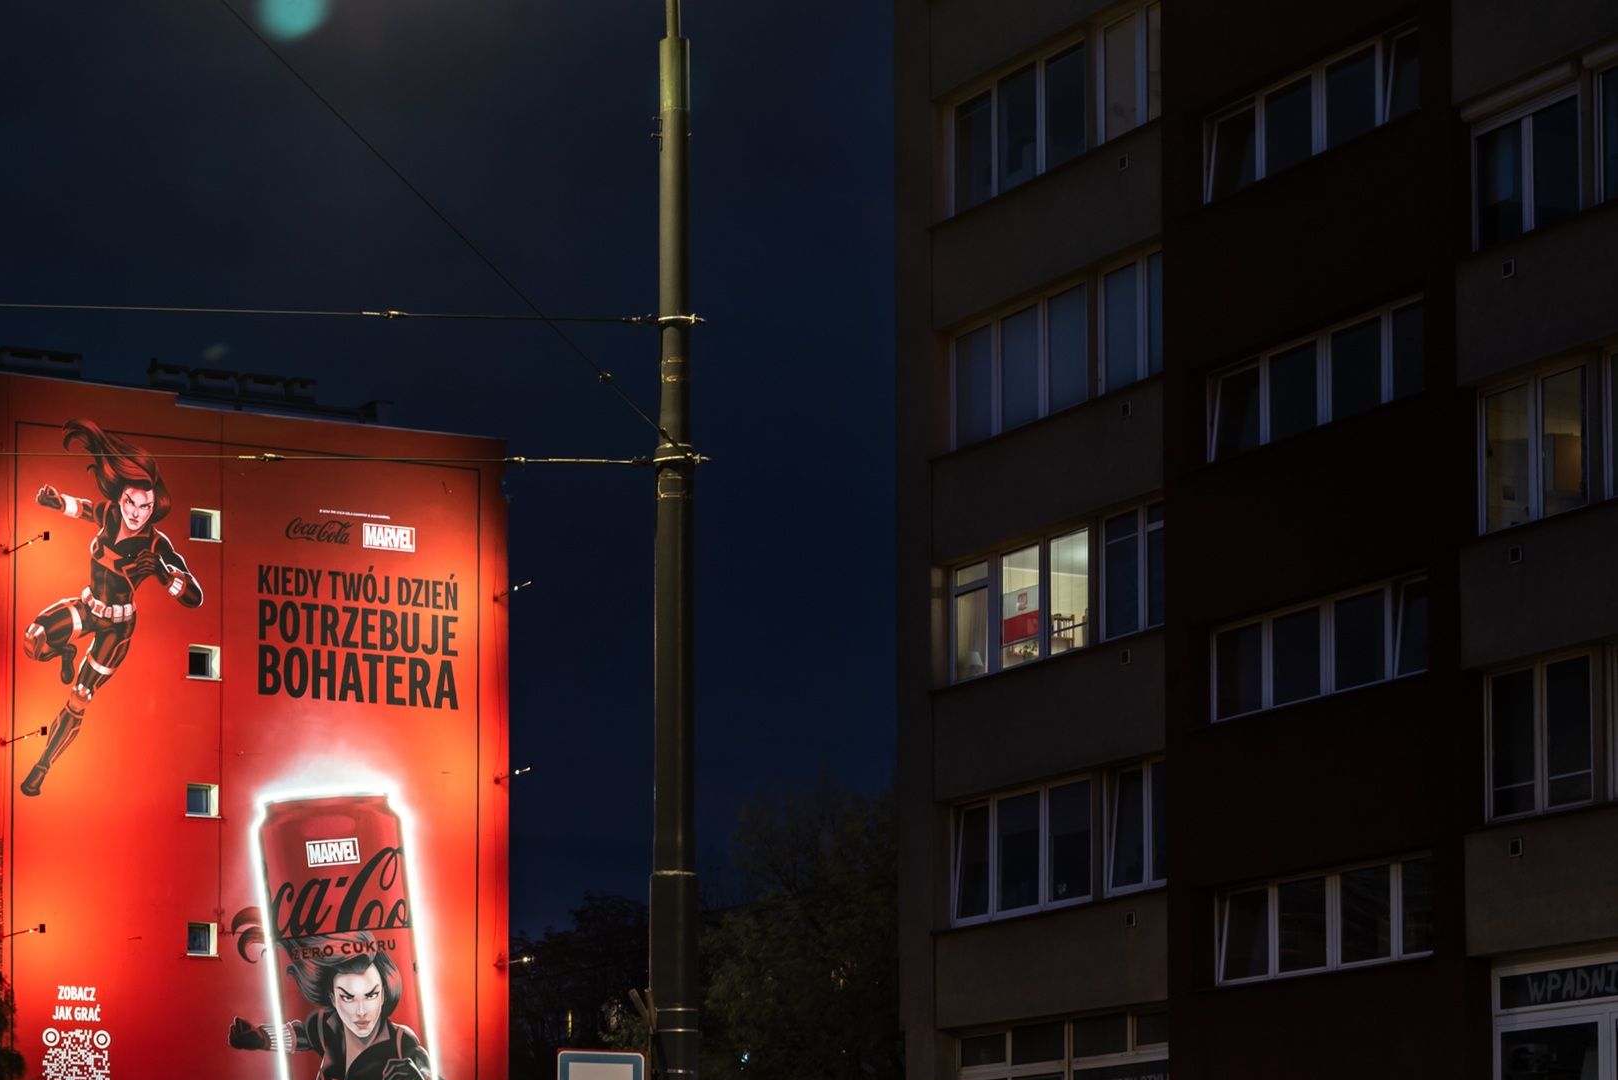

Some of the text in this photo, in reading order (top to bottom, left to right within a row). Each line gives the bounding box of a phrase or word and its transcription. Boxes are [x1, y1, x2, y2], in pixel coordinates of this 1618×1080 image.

[364, 524, 413, 550] MARVEL
[258, 564, 458, 611] KIEDY TWÓJ DZIEŃ
[258, 598, 459, 657] POTRZEBUJE
[257, 643, 459, 711] BOHATERA
[308, 840, 358, 865] MARVEL
[293, 938, 396, 960] ZERO CUKRU
[57, 985, 96, 1001] ZOBACZ
[1526, 962, 1618, 1003] WPADNI
[52, 1004, 101, 1022] JAK GRAĆ
